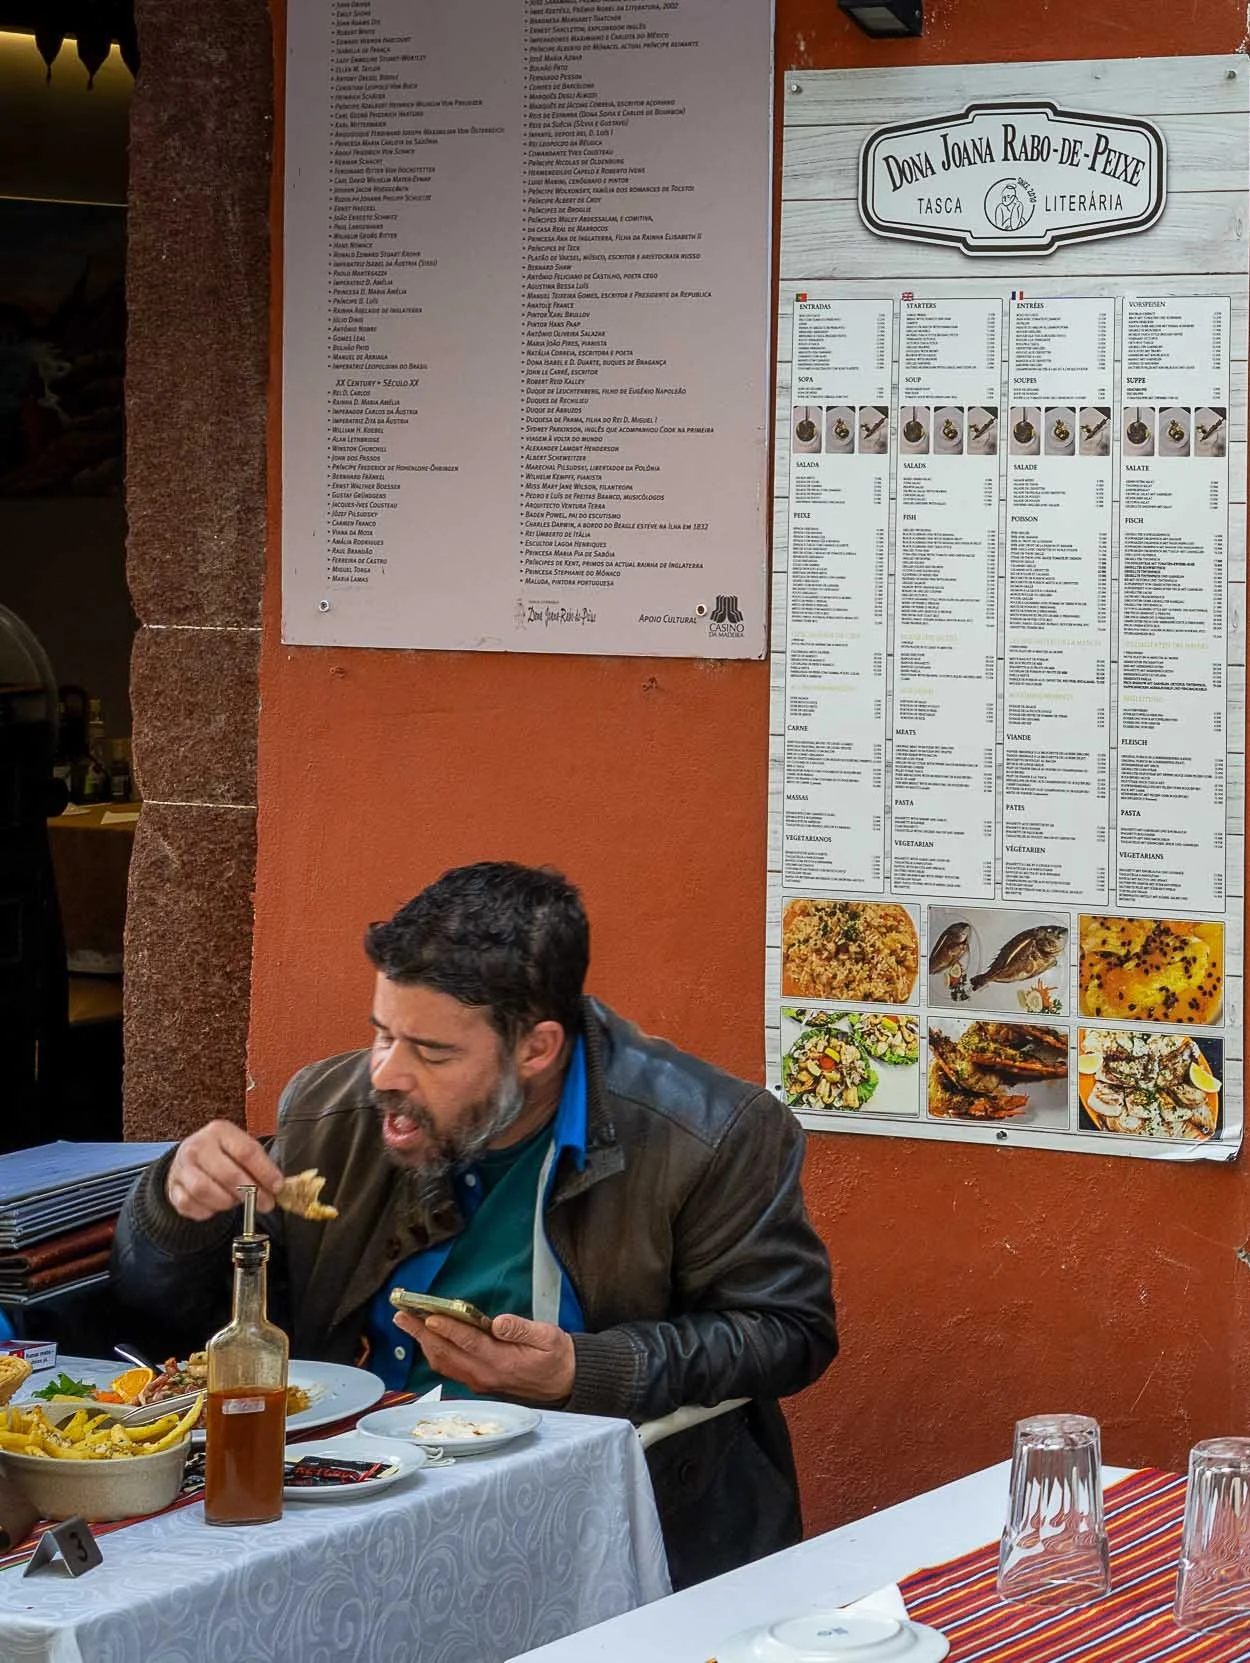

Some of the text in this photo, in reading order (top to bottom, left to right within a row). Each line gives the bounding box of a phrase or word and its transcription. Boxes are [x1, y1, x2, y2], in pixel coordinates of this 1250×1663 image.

[882, 123, 1146, 192] DONA JOANA RABO-DE-PEIXE
[918, 190, 1123, 214] TASCA LITERÁRIA
[638, 614, 697, 625] APOIO CULTURAL
[709, 623, 745, 632] CASINO
[1120, 809, 1141, 817] PASTA
[785, 834, 832, 843] VEGETARIANOS
[894, 840, 934, 848] VEGETARIAN
[1119, 851, 1164, 860] VEGETARIANS
